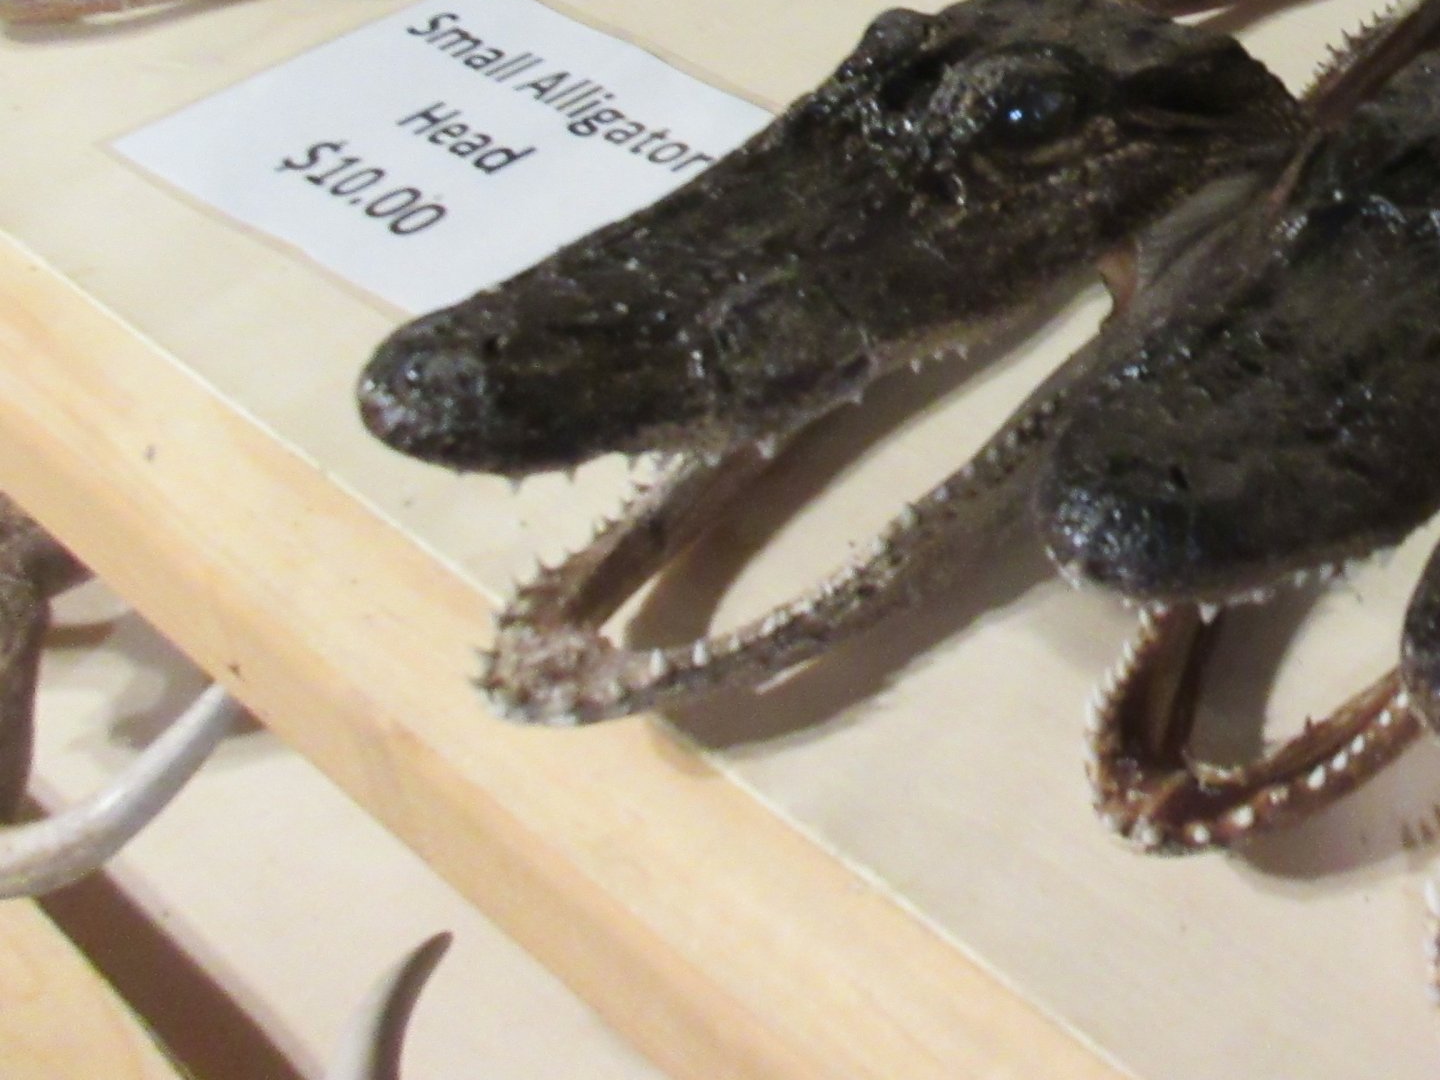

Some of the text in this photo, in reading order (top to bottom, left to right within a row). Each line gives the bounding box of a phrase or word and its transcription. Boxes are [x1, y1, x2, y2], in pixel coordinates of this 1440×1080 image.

[396, 102, 537, 175] Head
[406, 12, 716, 173] Small Alligator
[276, 139, 448, 237] $10.00
